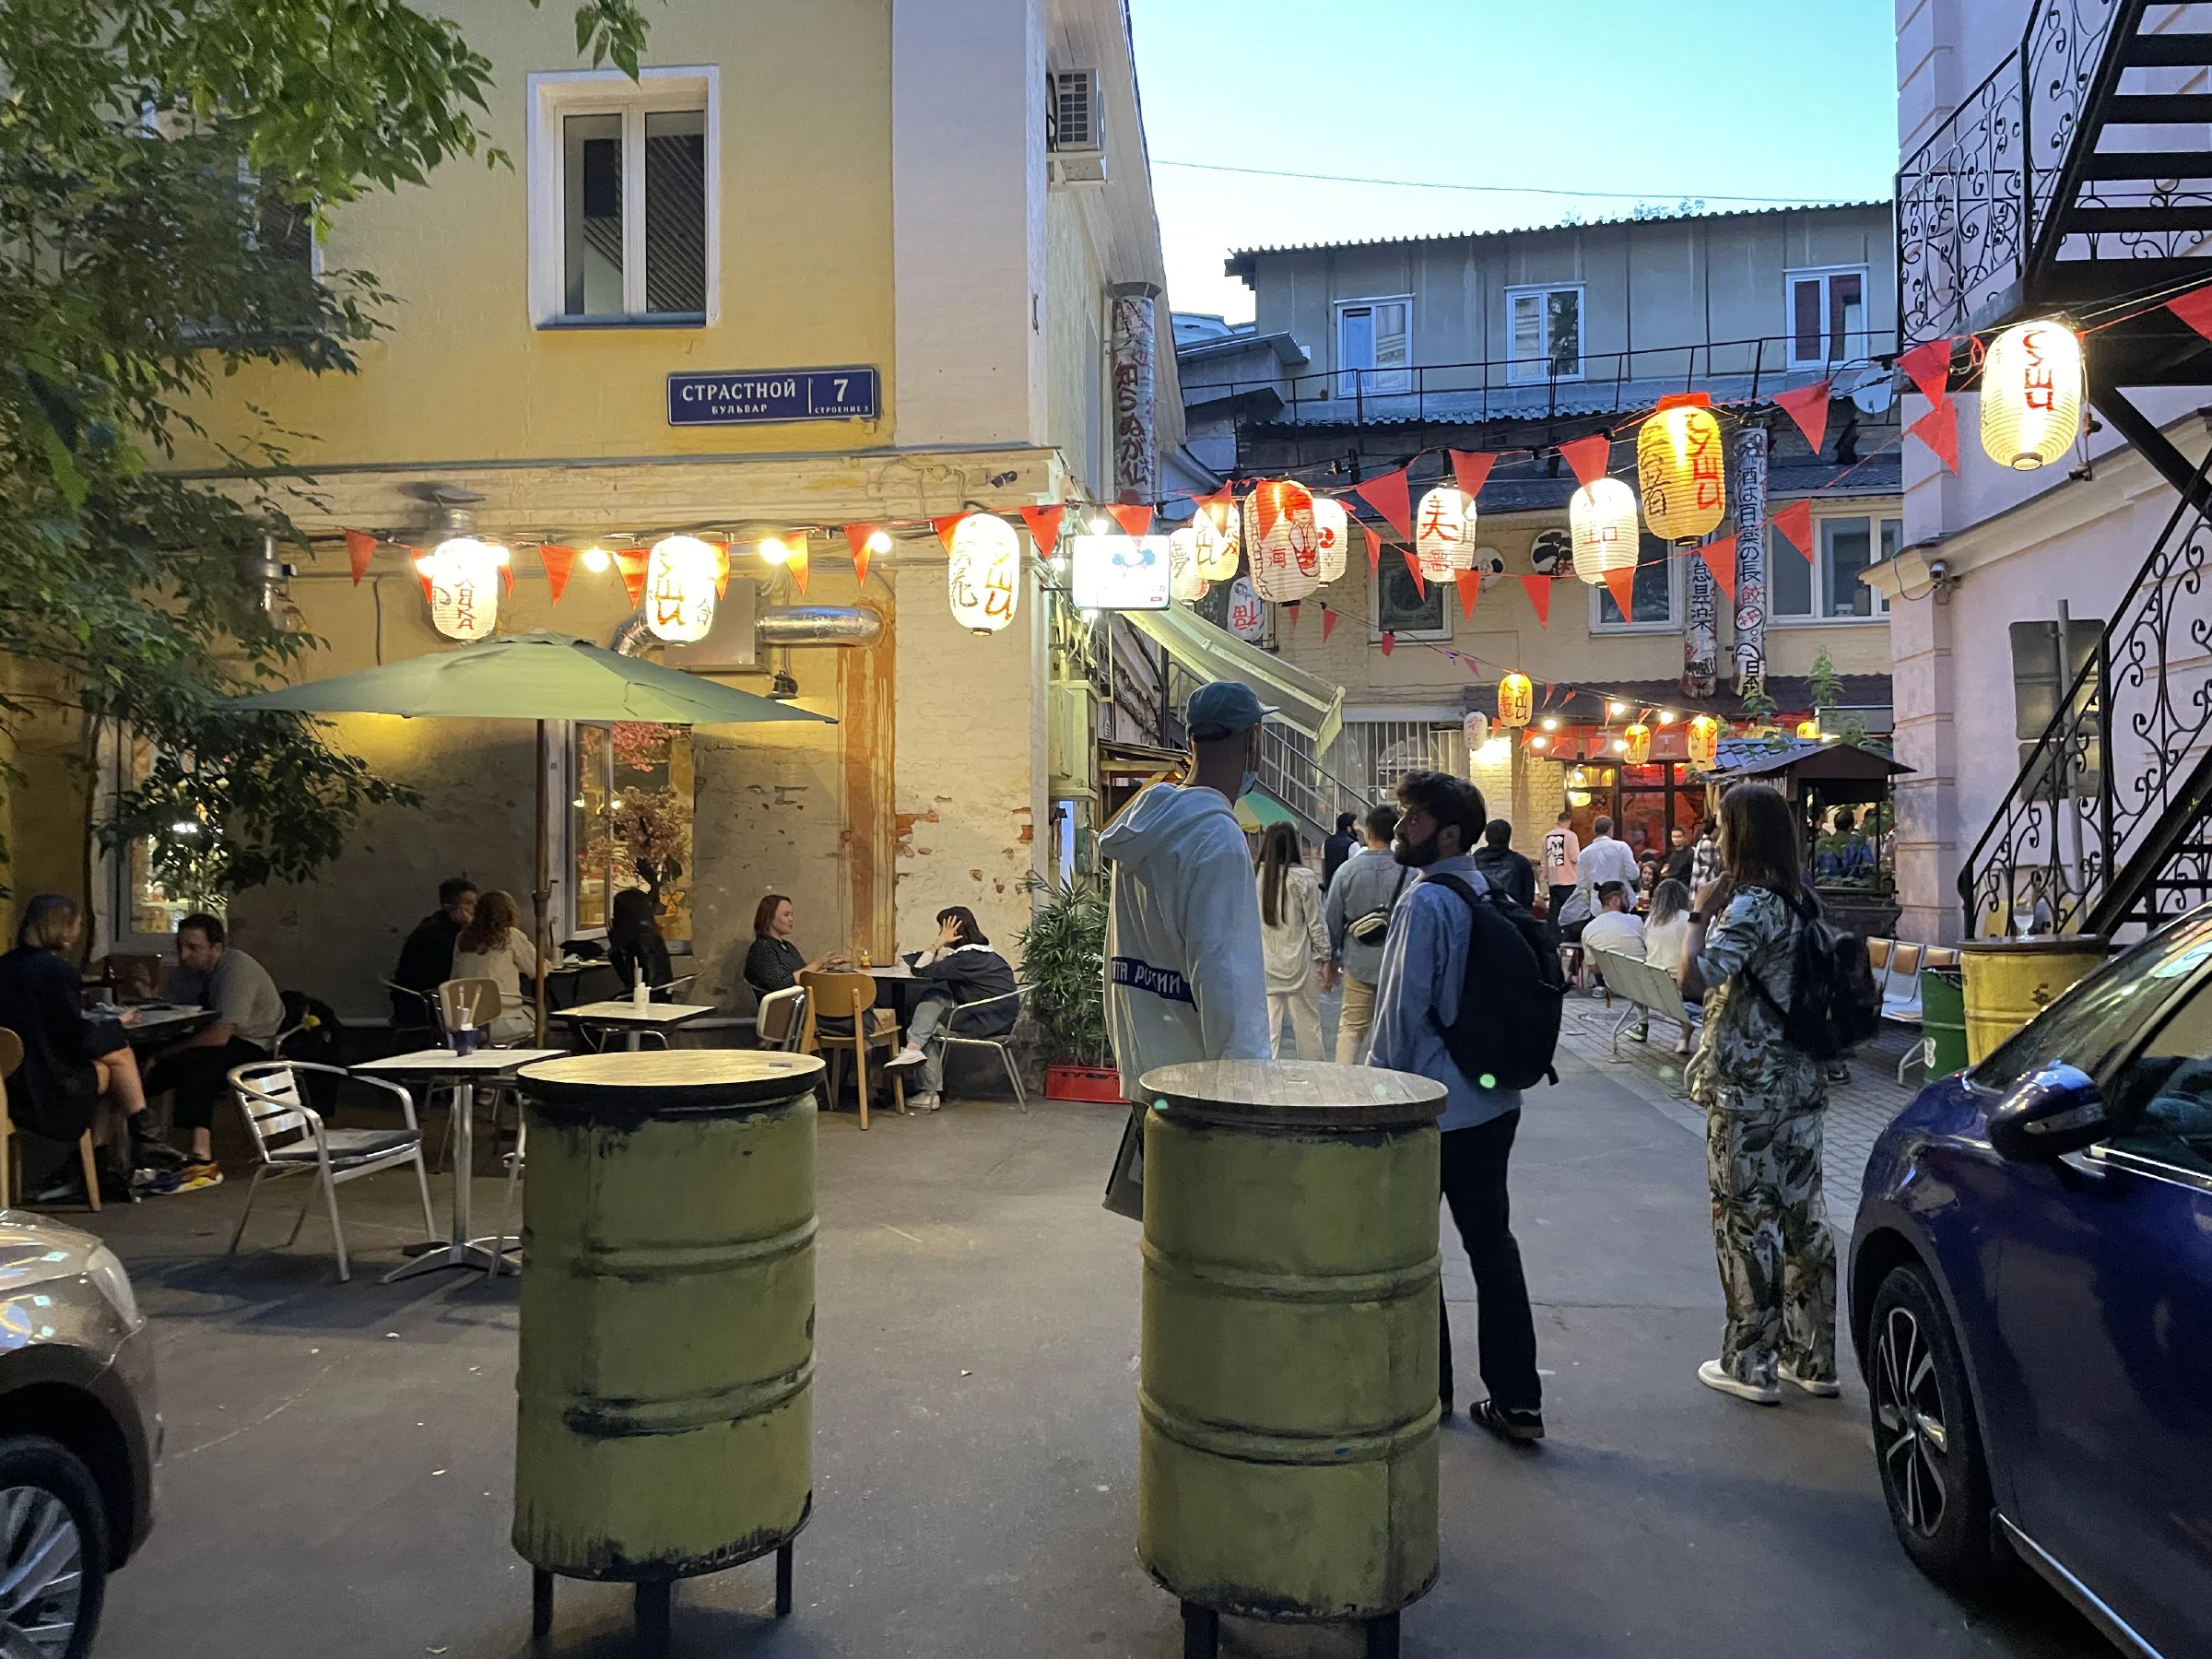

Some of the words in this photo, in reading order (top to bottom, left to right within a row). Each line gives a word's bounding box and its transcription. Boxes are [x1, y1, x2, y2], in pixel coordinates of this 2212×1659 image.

[682, 379, 796, 401] СТРАСТНОЙ
[833, 379, 849, 402] 7
[712, 404, 768, 415] БУЛЬВАР
[815, 406, 862, 415] СТРОЕНИЕ
